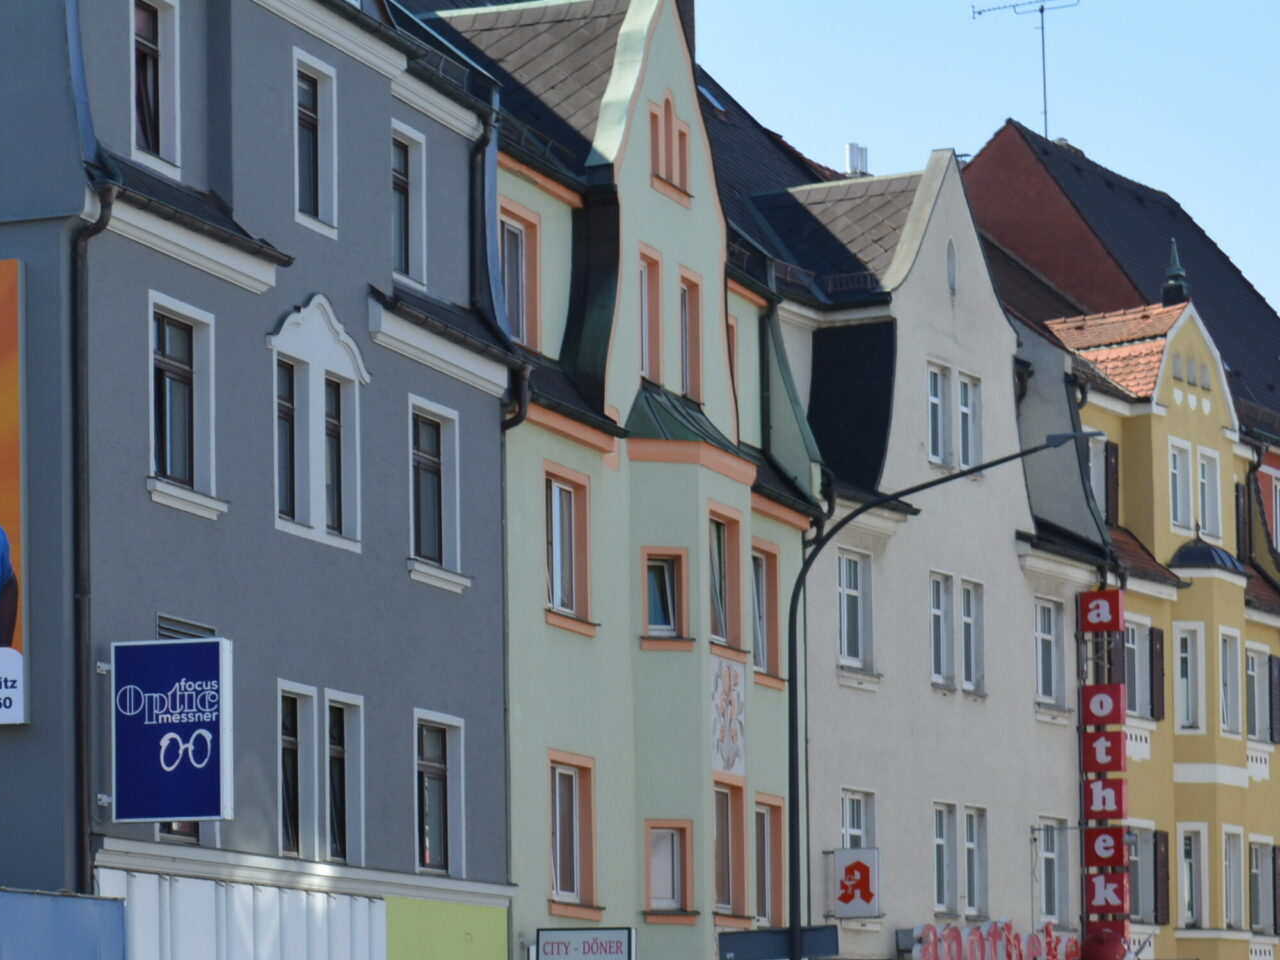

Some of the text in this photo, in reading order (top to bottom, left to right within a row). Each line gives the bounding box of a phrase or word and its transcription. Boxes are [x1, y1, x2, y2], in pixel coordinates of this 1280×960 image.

[180, 678, 218, 691] focus
[116, 682, 219, 725] Optic
[158, 711, 218, 724] messner
[542, 941, 571, 956] CITY
[582, 937, 624, 956] DÖNER
